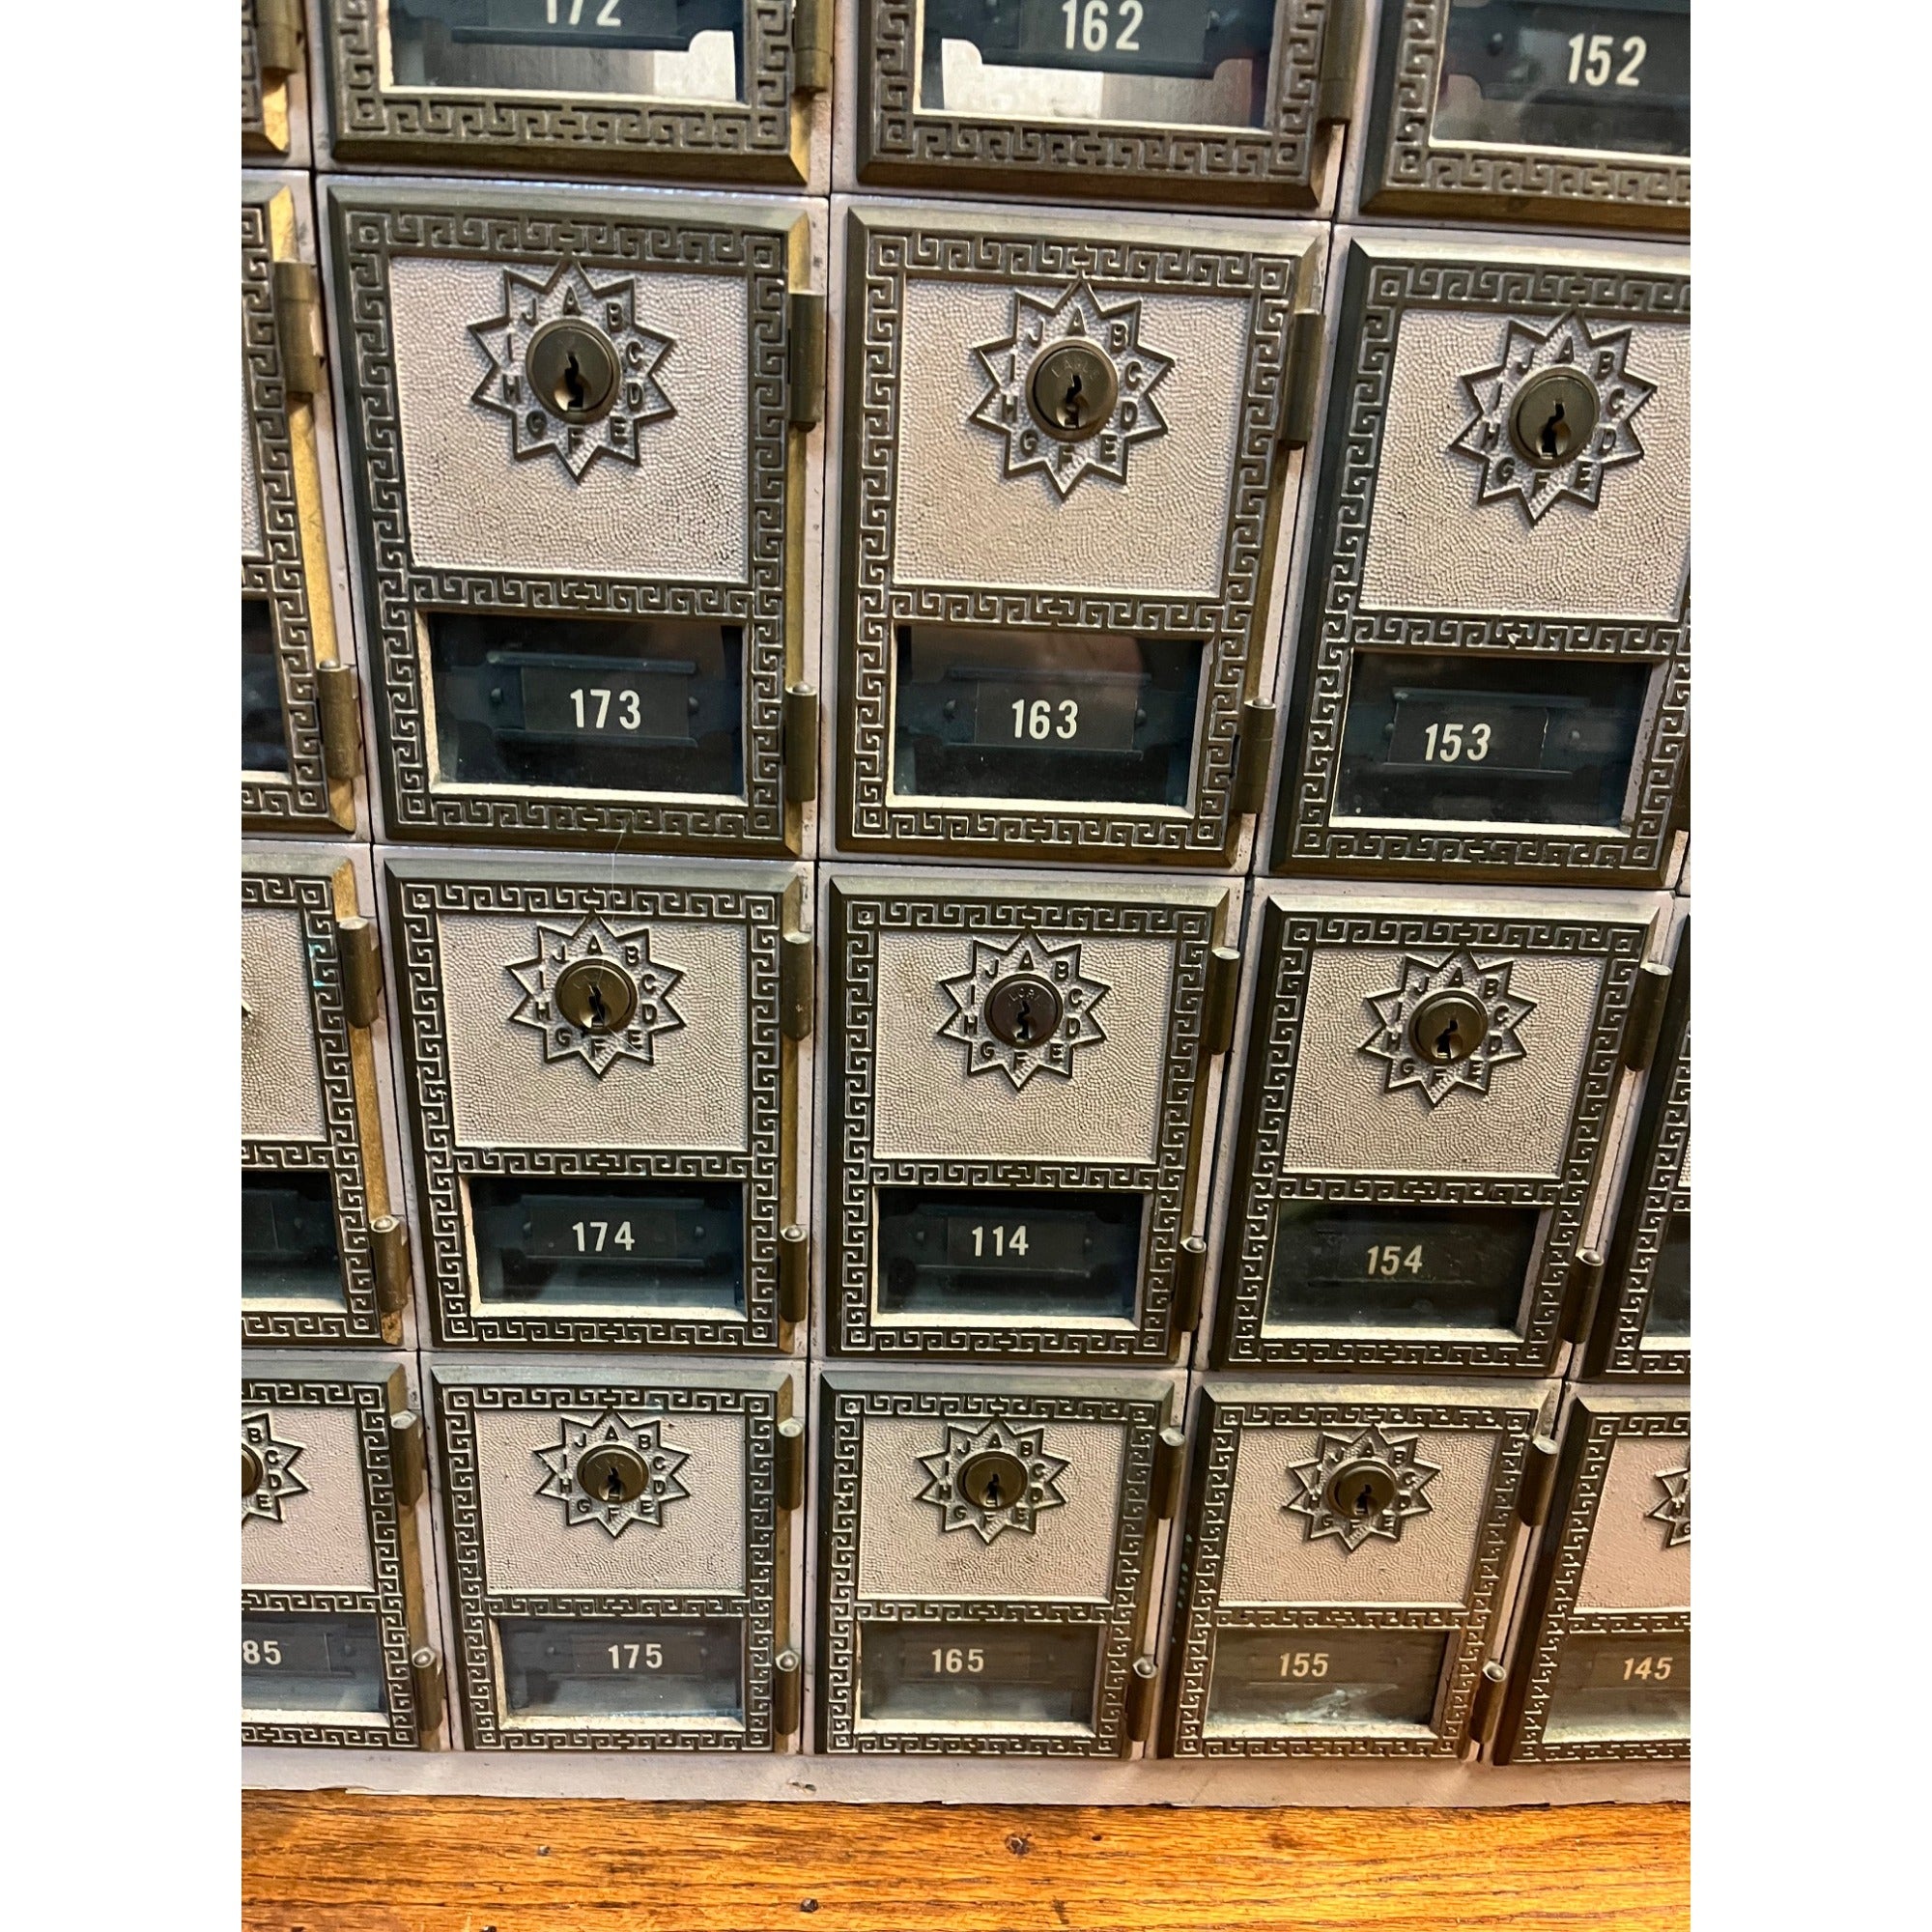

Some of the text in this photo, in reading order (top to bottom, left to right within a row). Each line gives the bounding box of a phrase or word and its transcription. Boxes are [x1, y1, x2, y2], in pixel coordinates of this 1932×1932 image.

[1063, 0, 1144, 52] 162
[1568, 33, 1647, 87] 152
[563, 286, 582, 316] A
[522, 298, 538, 327] J
[607, 302, 623, 332] B
[1066, 306, 1087, 336] A
[1027, 319, 1044, 348] J
[1110, 324, 1128, 354] B
[626, 341, 643, 370] C
[1555, 336, 1574, 364] A
[1514, 348, 1535, 375] J
[1594, 351, 1615, 381] B
[1124, 360, 1143, 390] C
[502, 374, 522, 404] H
[627, 383, 643, 412] D
[1002, 395, 1018, 422] H
[1606, 388, 1625, 417] C
[526, 410, 547, 439] G
[1121, 401, 1138, 430] D
[610, 416, 628, 444] E
[1481, 422, 1501, 449] H
[568, 427, 584, 455] F
[1019, 429, 1038, 457] G
[1100, 434, 1118, 462] E
[1597, 428, 1617, 455] D
[1058, 444, 1074, 471] F
[1495, 457, 1516, 485] G
[1573, 461, 1592, 489] E
[1532, 471, 1551, 497] F
[570, 688, 641, 730] 173
[1011, 698, 1078, 740] 163
[1425, 723, 1492, 762] 153
[552, 944, 569, 964] J
[586, 934, 603, 955] A
[625, 946, 639, 965] B
[1018, 950, 1034, 971] A
[984, 959, 1000, 980] J
[1055, 961, 1068, 981] B
[1448, 967, 1463, 987] A
[641, 974, 656, 993] C
[1414, 977, 1430, 996] J
[1483, 979, 1498, 999] B
[1068, 988, 1083, 1008] C
[535, 1002, 552, 1020] H
[641, 1004, 657, 1024] D
[1493, 1006, 1509, 1024] C
[964, 1015, 978, 1035] H
[1065, 1018, 1081, 1037] D
[555, 1028, 573, 1046] G
[627, 1029, 643, 1049] E
[1386, 1032, 1402, 1051] H
[1487, 1036, 1502, 1055] D
[590, 1038, 606, 1058] F
[980, 1040, 996, 1060] G
[1049, 1043, 1064, 1062] E
[1013, 1051, 1028, 1070] F
[1400, 1058, 1414, 1076] G
[1468, 1061, 1483, 1079] E
[1431, 1068, 1446, 1086] F
[572, 1221, 636, 1252] 174
[972, 1225, 1029, 1257] 114
[1367, 1244, 1423, 1276] 154
[574, 1433, 586, 1448] J
[605, 1425, 619, 1440] A
[639, 1435, 651, 1449] B
[987, 1433, 1003, 1449] A
[956, 1439, 971, 1456] J
[1020, 1441, 1033, 1457] B
[247, 1427, 282, 1509] B C D E
[653, 1456, 666, 1470] C
[1032, 1463, 1045, 1479] C
[559, 1479, 572, 1493] H
[653, 1480, 666, 1494] D
[938, 1485, 952, 1500] H
[1029, 1488, 1043, 1503] D
[577, 1498, 591, 1513] G
[608, 1507, 619, 1522] F
[640, 1500, 653, 1515] E
[953, 1505, 967, 1520] G
[1013, 1507, 1028, 1523] E
[981, 1514, 995, 1529] F
[608, 1643, 664, 1669] 175
[931, 1648, 984, 1673] 165
[1280, 1653, 1329, 1677] 155
[1623, 1657, 1673, 1681] 145
